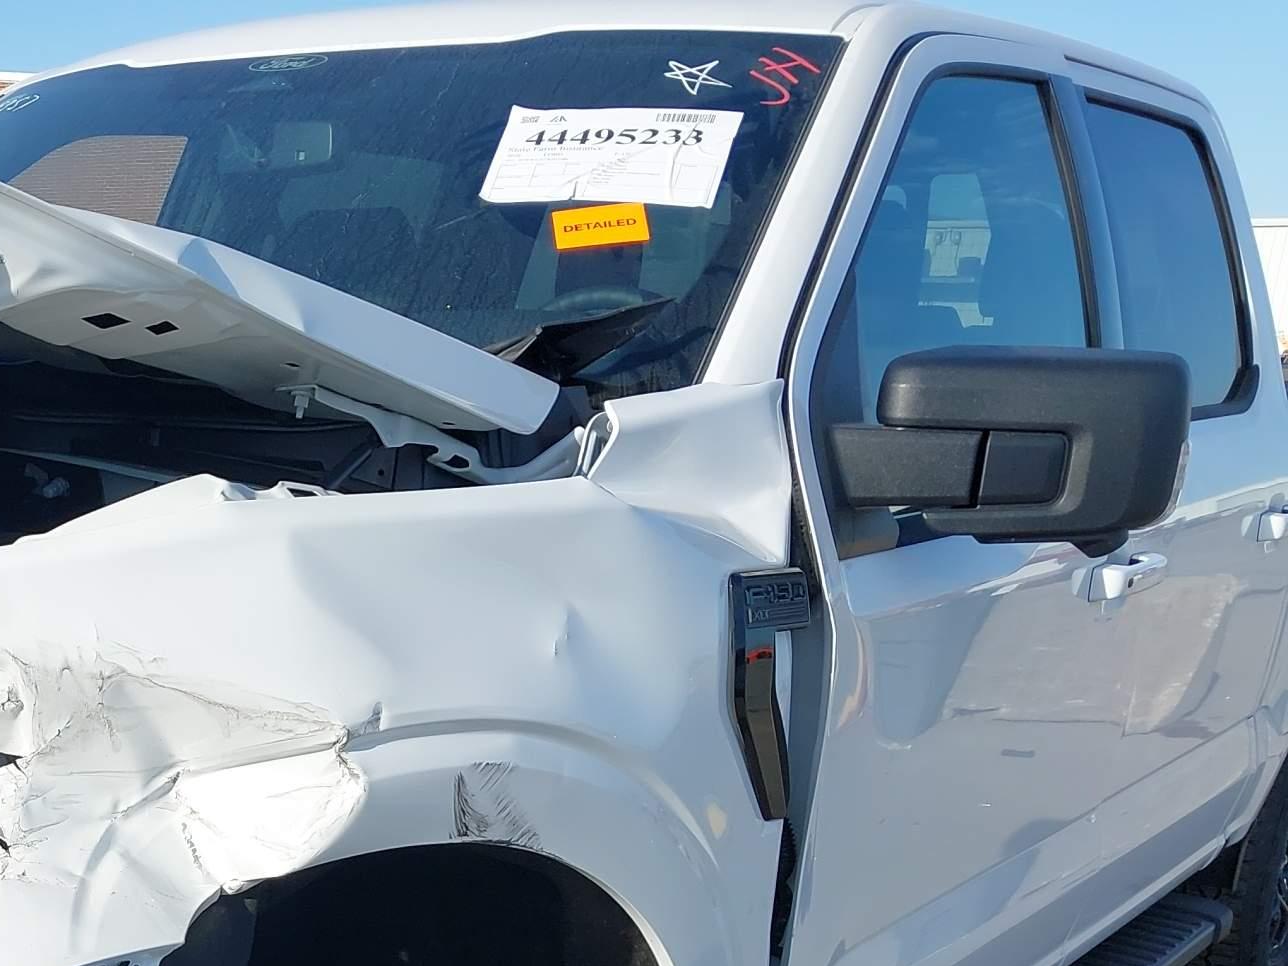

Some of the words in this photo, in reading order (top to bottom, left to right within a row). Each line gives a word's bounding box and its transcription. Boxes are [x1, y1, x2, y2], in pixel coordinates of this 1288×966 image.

[525, 127, 704, 146] 44495233
[563, 217, 637, 233] DETAILED
[753, 609, 770, 620] XLT
